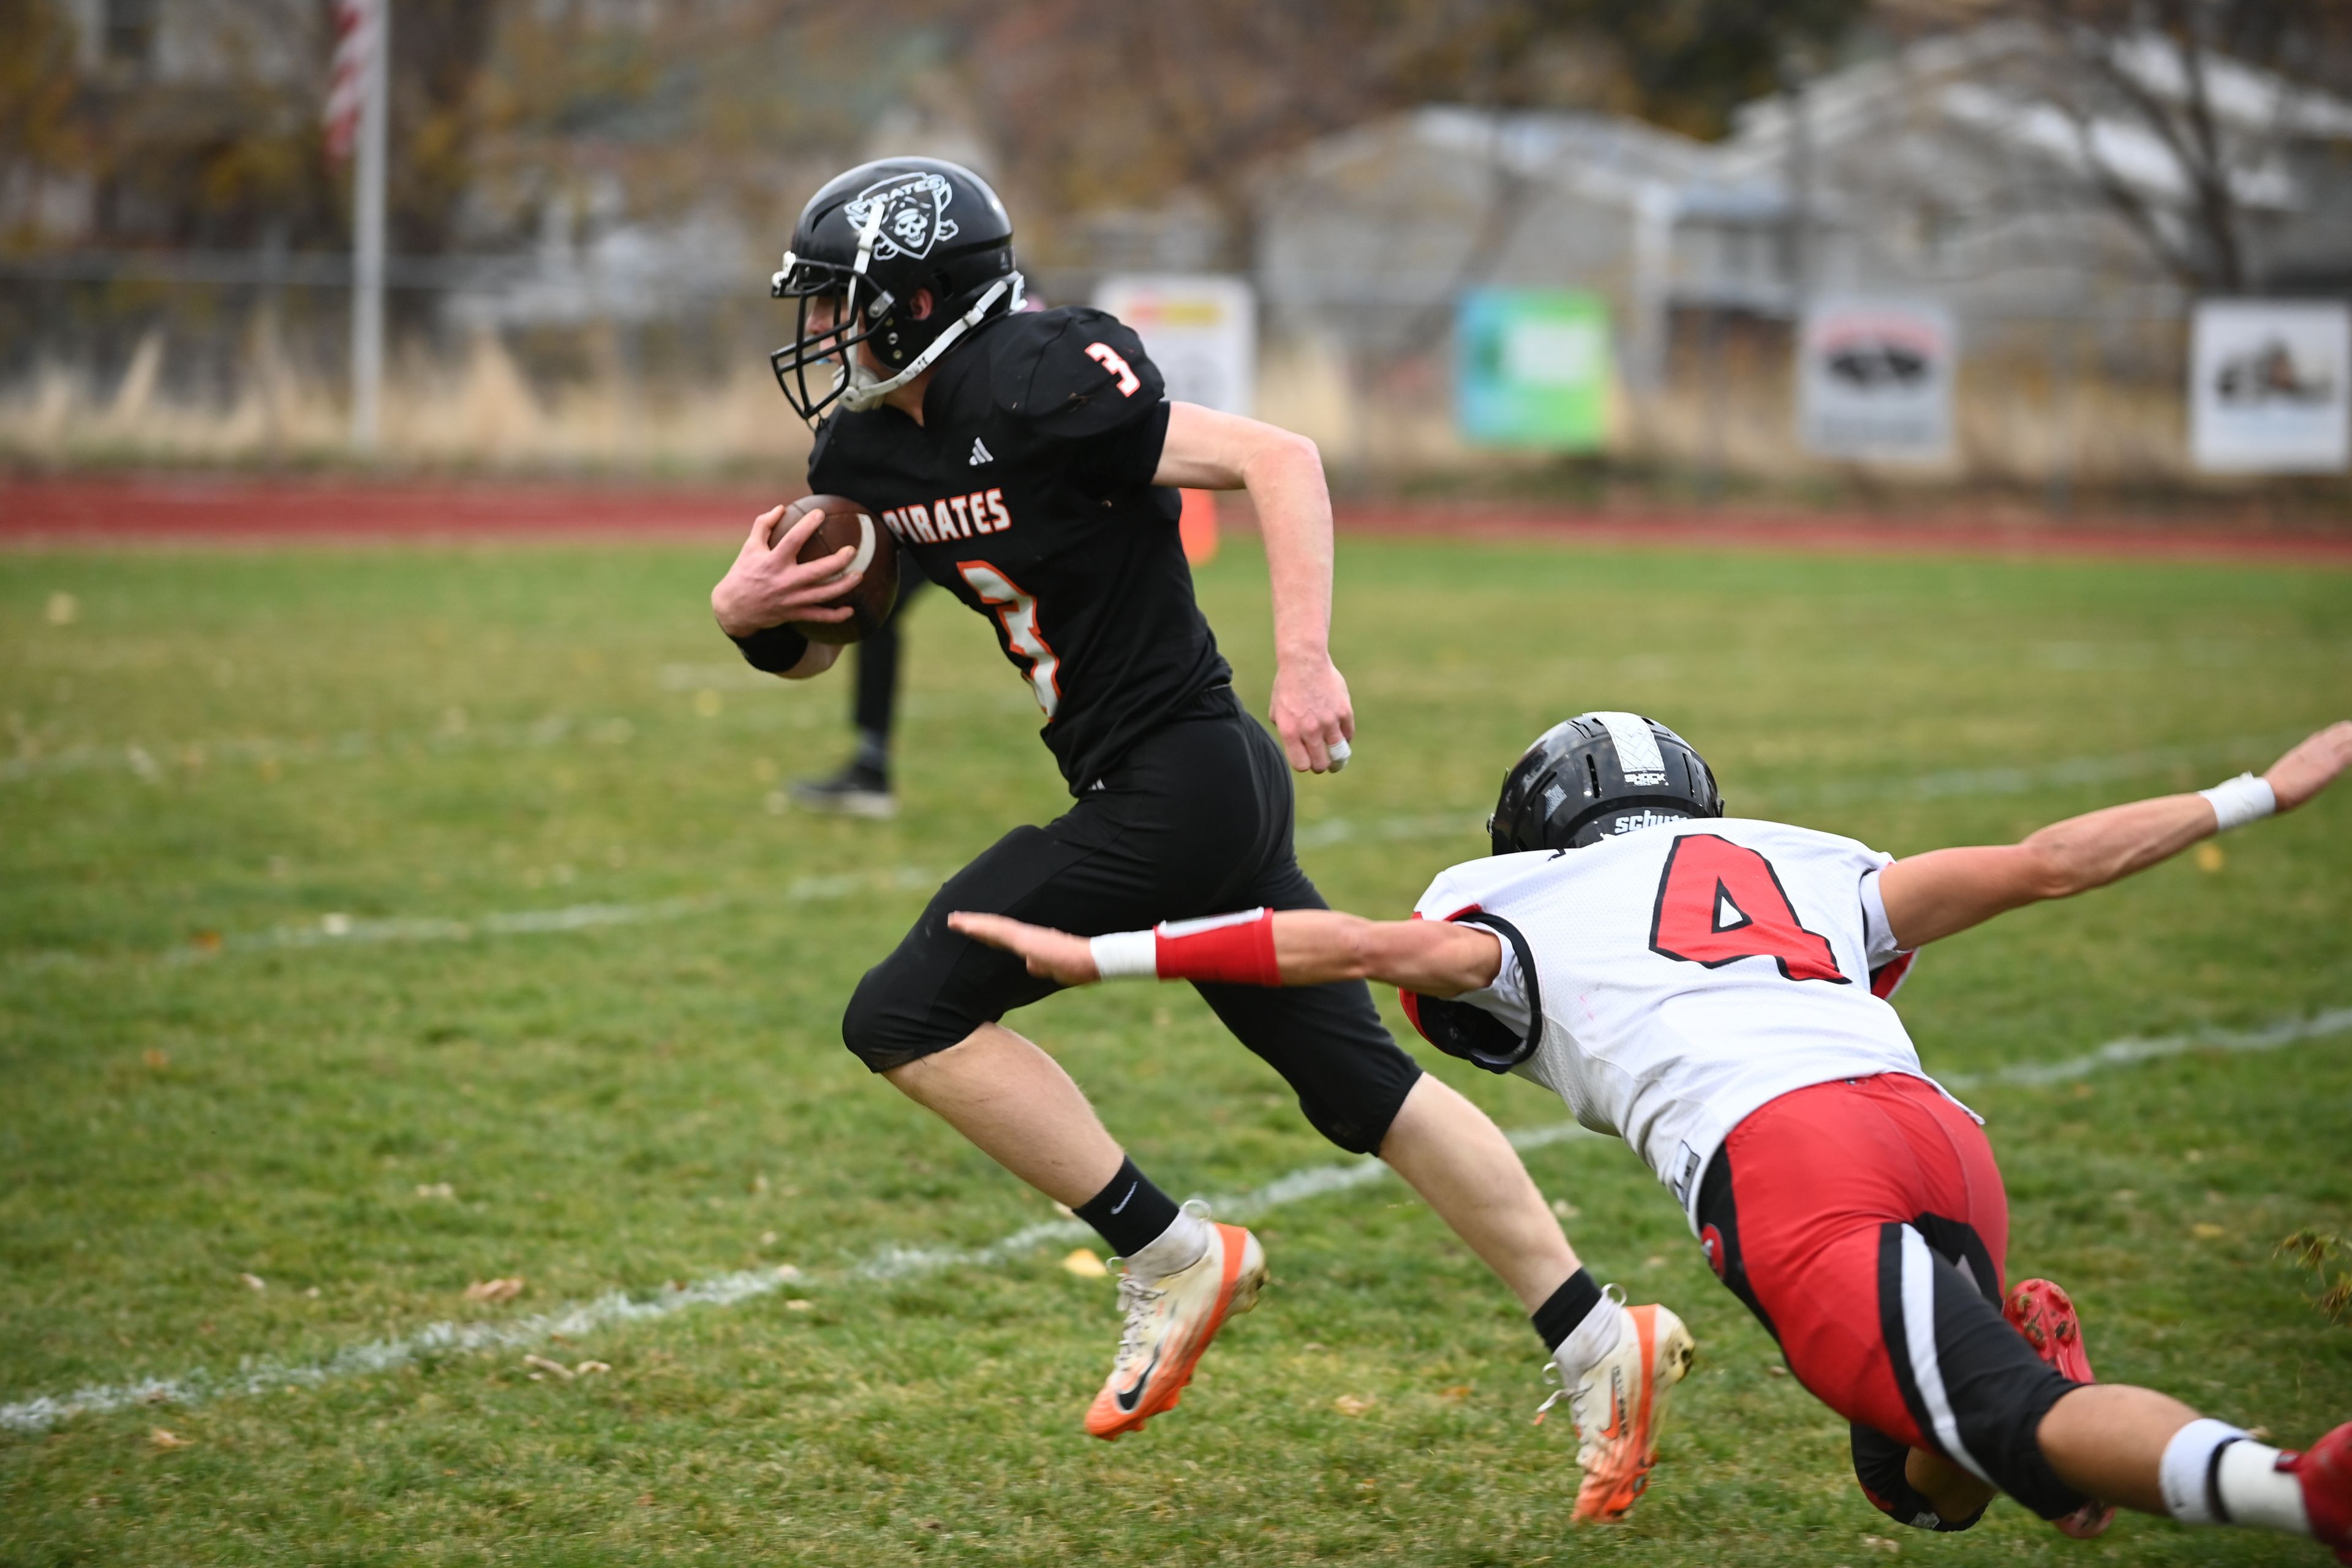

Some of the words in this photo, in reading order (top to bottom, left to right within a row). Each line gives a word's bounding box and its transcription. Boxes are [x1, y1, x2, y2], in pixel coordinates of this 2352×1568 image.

[1084, 342, 1140, 398] 3
[882, 488, 1012, 544] PIRATES
[956, 560, 1062, 723] 3
[1648, 833, 1853, 985] 4
